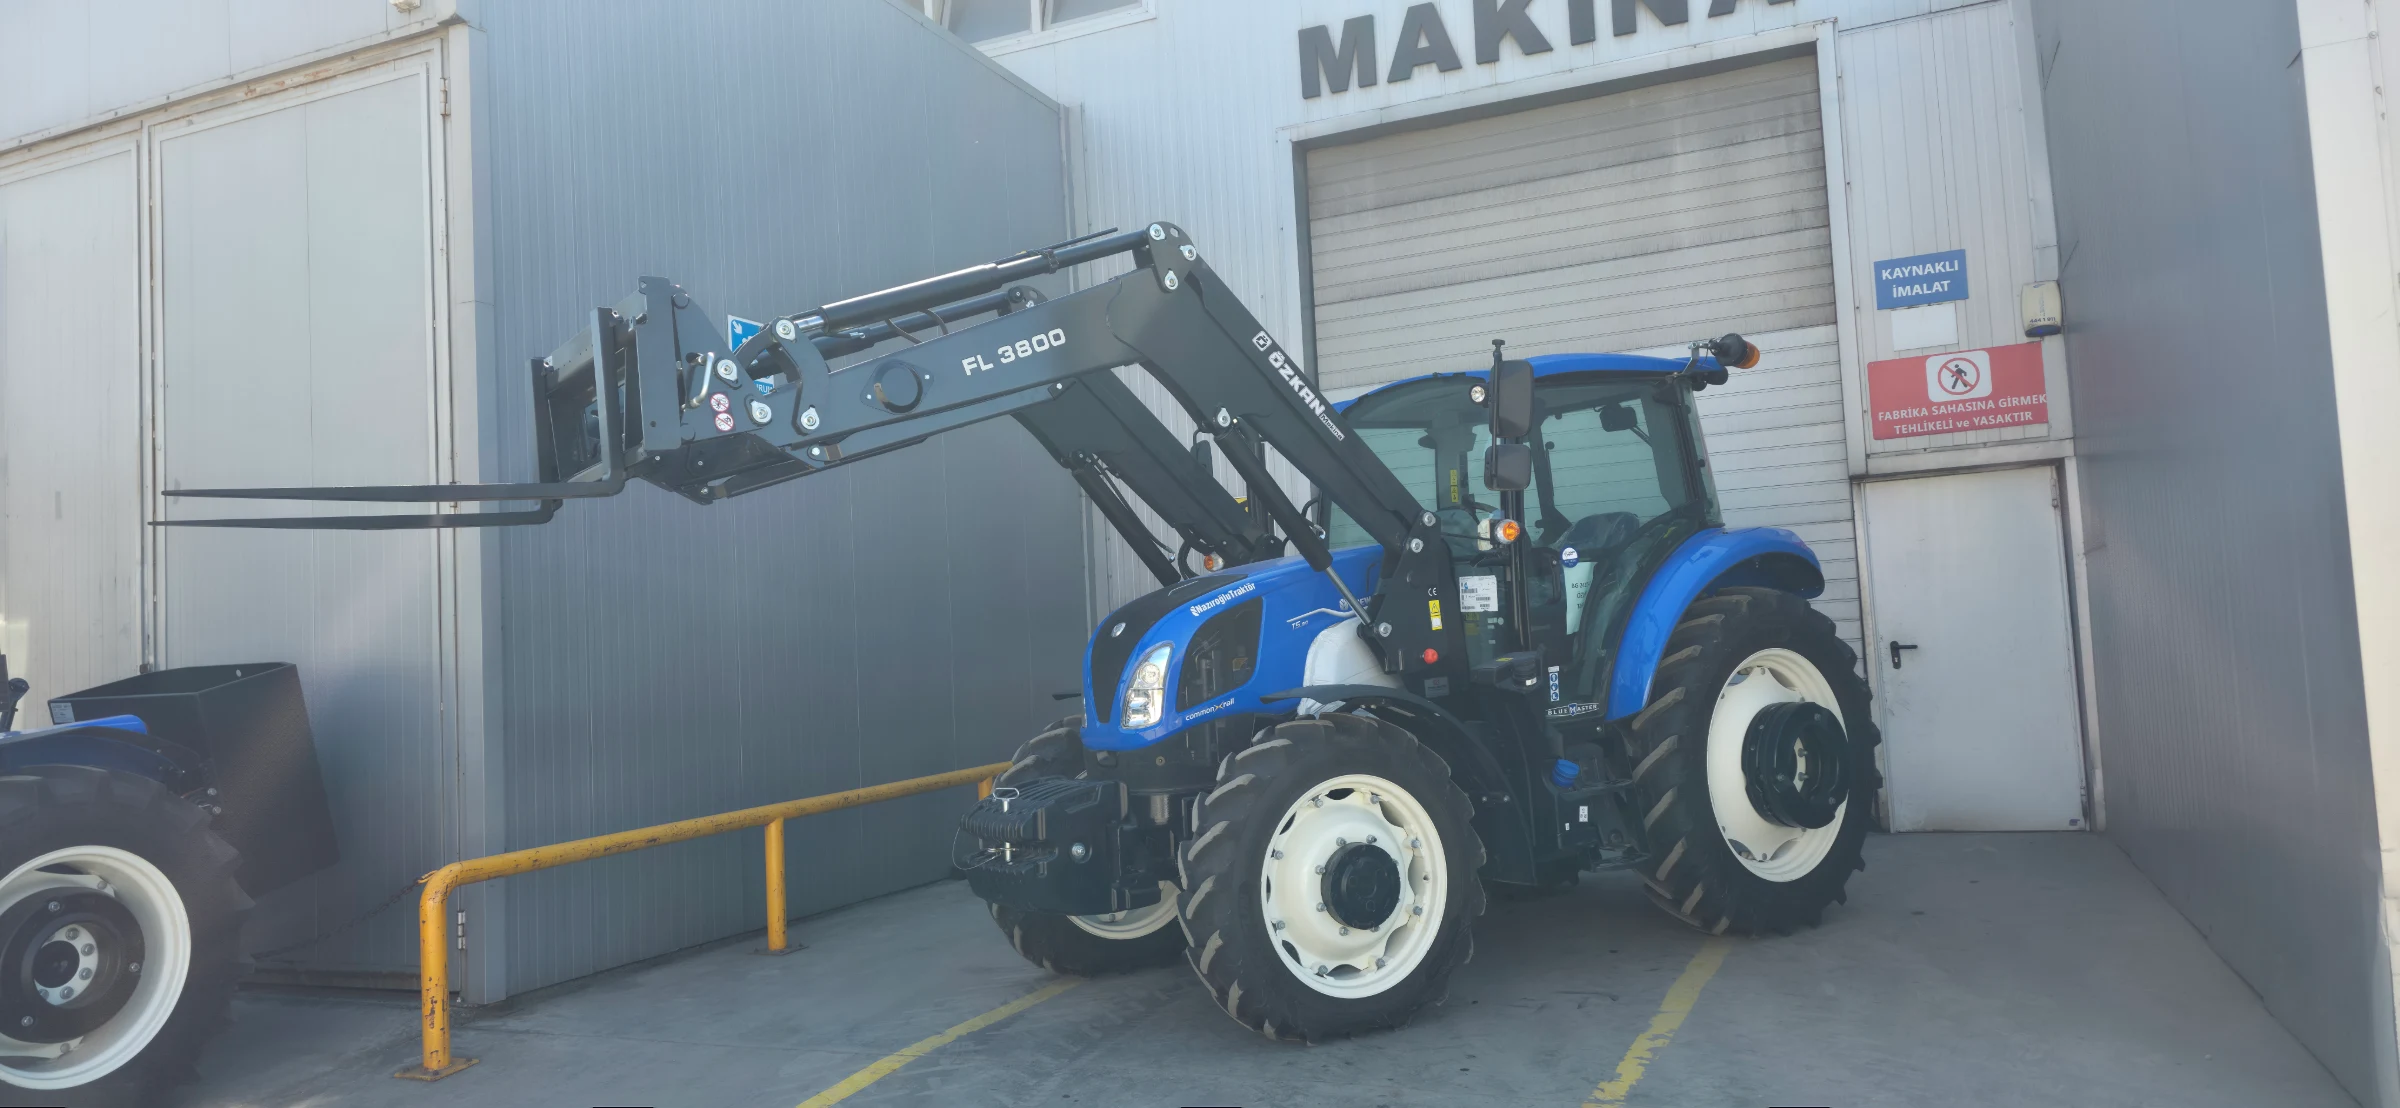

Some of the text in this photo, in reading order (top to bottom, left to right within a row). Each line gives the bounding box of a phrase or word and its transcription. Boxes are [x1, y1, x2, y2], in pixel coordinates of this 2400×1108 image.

[1298, 0, 1797, 99] MAKIN
[1881, 259, 1959, 281] KAYNAKLI
[1892, 279, 1951, 298] İMALAT
[961, 327, 1066, 376] FL 3800
[1268, 351, 1325, 417] ÖZKAN
[1878, 393, 2047, 422] FABRİKA SAHASINA GİRMEK
[1894, 411, 2033, 435] TEHLİKELİ ve YASAKTIR
